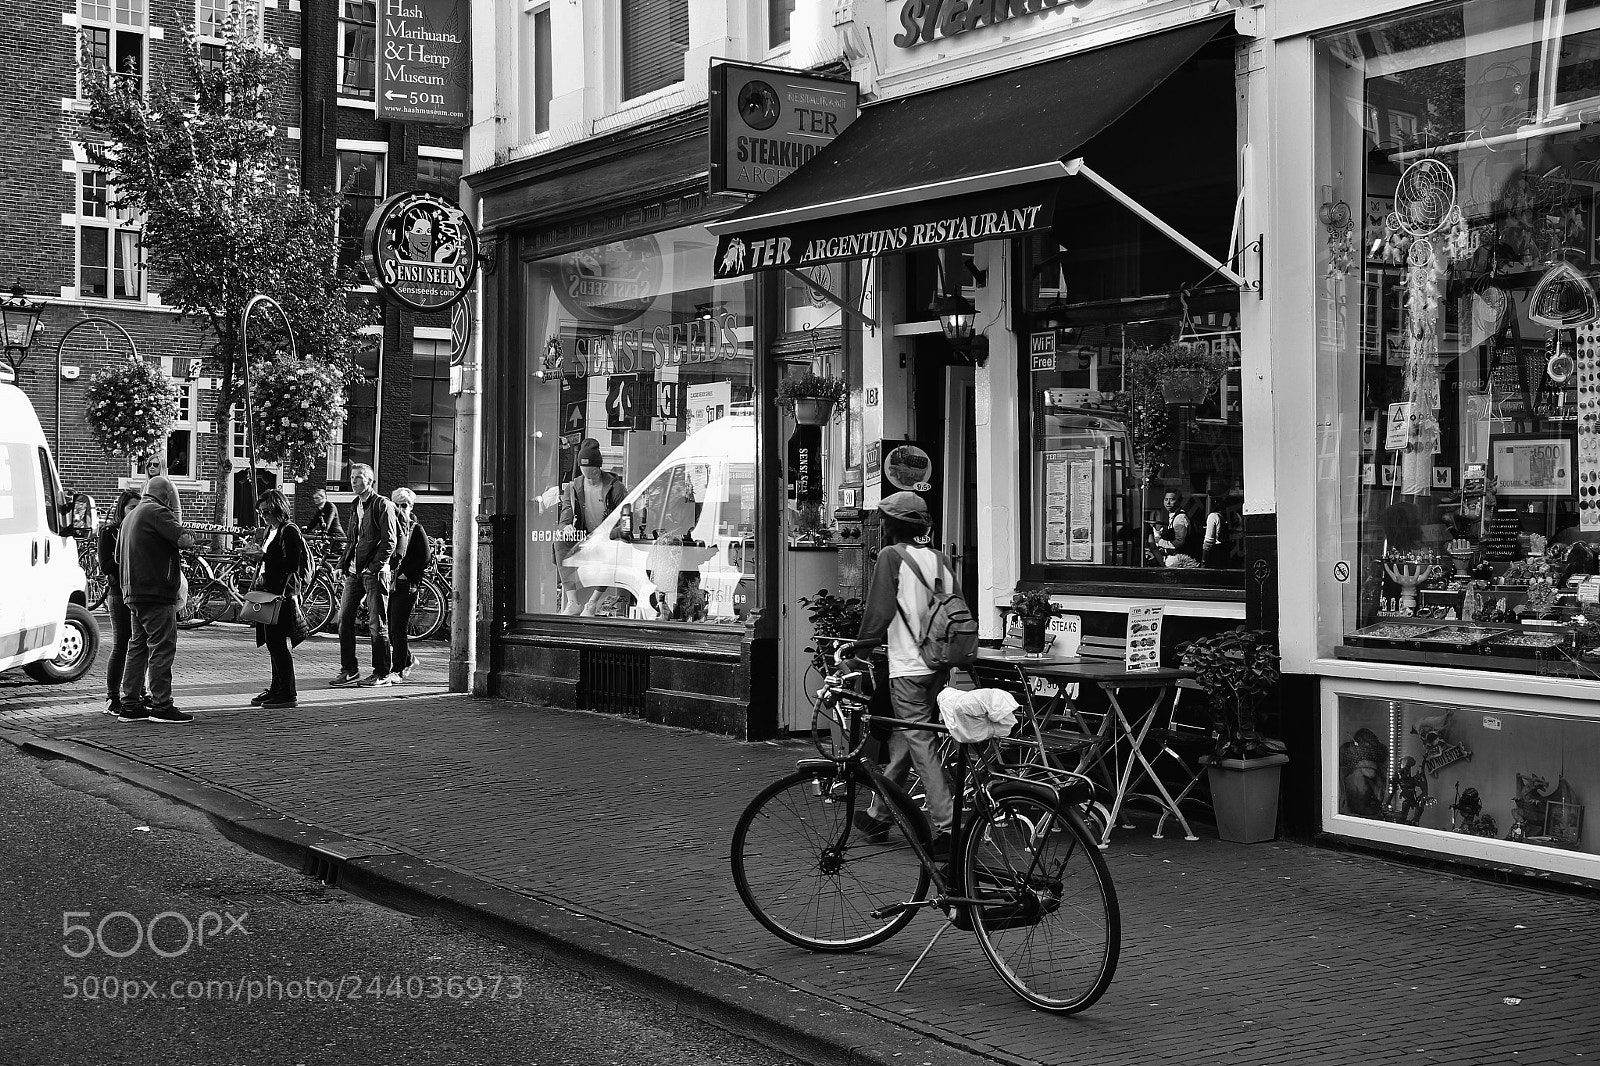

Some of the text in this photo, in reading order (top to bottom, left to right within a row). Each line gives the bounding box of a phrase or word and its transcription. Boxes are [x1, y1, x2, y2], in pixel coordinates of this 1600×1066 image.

[386, 0, 423, 19] Hash
[385, 18, 462, 44] Marihuana
[384, 40, 451, 68] & Hemp
[384, 63, 445, 86] Museum
[384, 105, 464, 118] www.hashmuseum.com
[794, 107, 839, 135] TER
[737, 135, 826, 168] STEAKHO
[750, 237, 792, 269] TER
[910, 204, 1043, 247] RESTAURANT
[385, 260, 465, 289] SENSI SEEDS
[574, 313, 738, 379] SENSI SEEDS
[1032, 336, 1054, 351] WiFi
[1033, 356, 1053, 368] Free
[866, 388, 875, 405] 18
[799, 448, 809, 474] SENSI
[845, 492, 854, 505] 20
[1051, 620, 1077, 633] STEAKS
